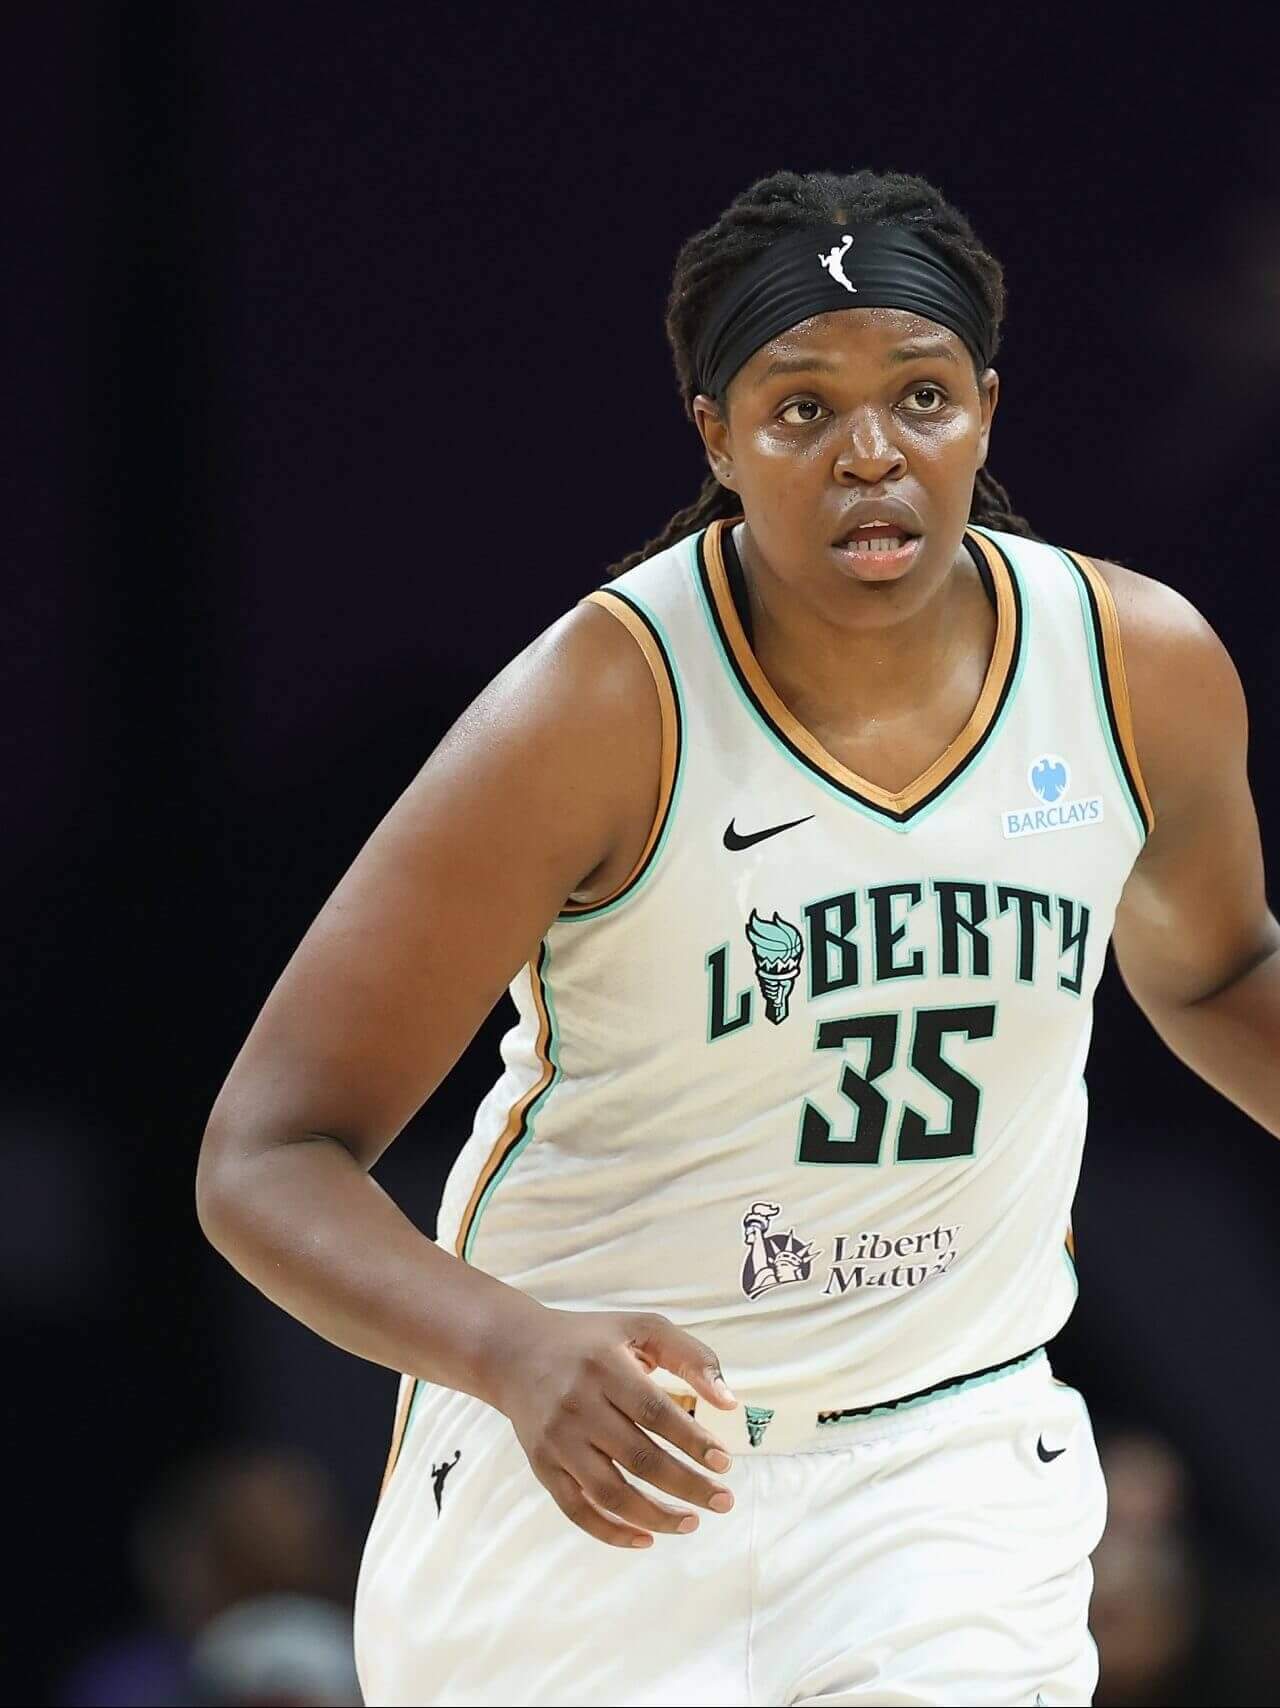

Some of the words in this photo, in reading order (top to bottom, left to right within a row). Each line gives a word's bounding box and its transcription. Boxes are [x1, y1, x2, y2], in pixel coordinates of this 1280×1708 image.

[1007, 800, 1099, 834] BARCLAYS
[795, 1001, 999, 1167] 35
[834, 1224, 961, 1263] Liberty
